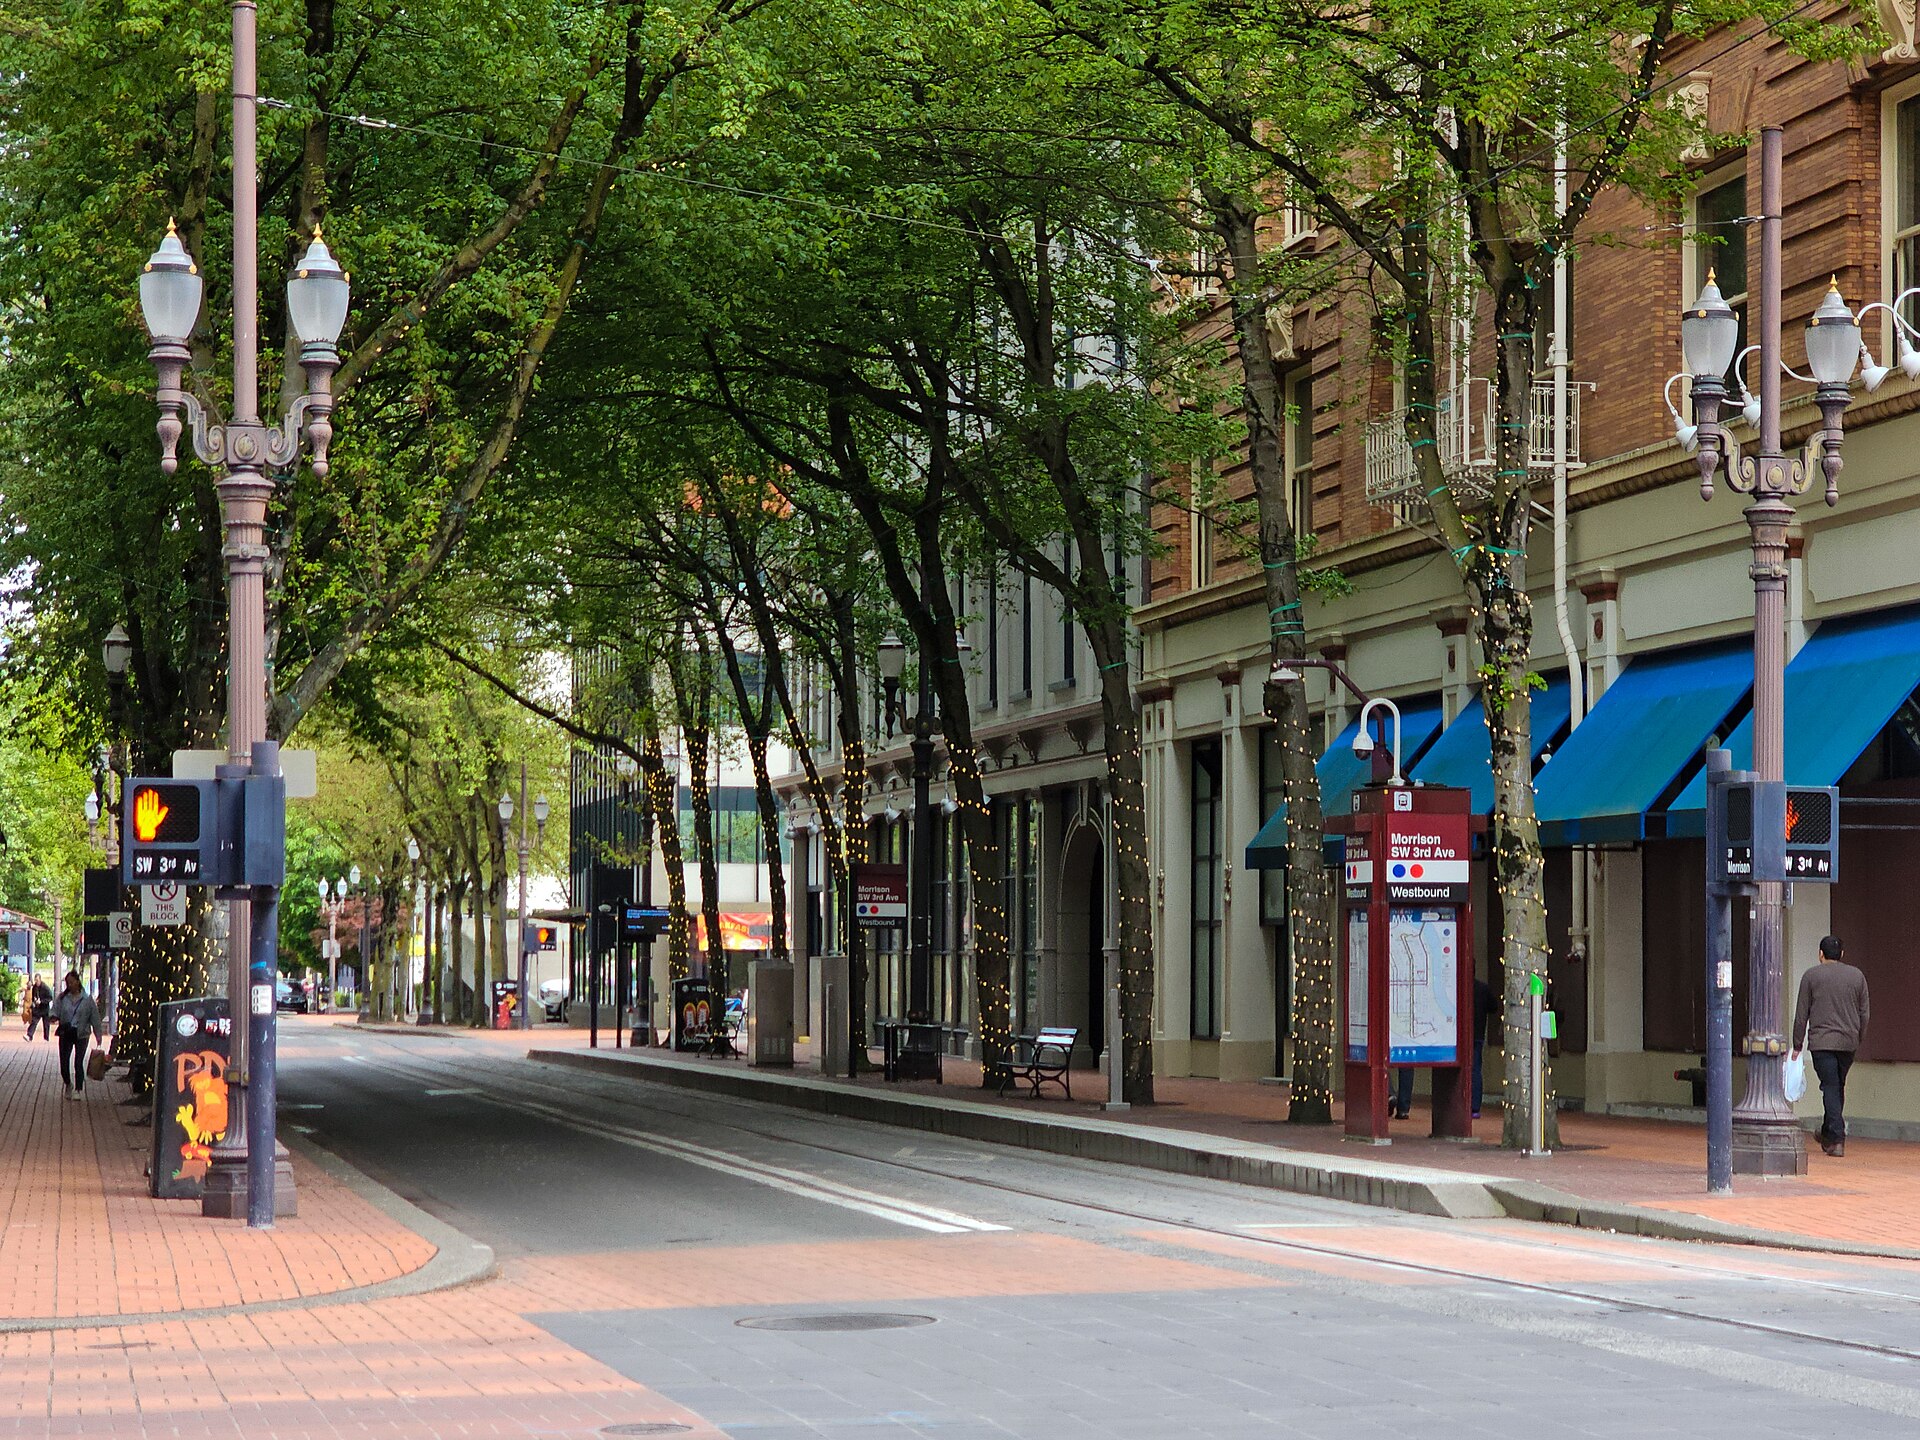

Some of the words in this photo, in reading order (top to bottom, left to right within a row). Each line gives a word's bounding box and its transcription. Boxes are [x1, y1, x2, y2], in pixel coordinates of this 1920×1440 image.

[1391, 832, 1441, 845] Morrison
[1391, 846, 1410, 858] SW
[1412, 846, 1431, 858] 3rd
[1434, 846, 1455, 858] Ave
[136, 856, 153, 873] SW
[160, 856, 177, 873] 3rd
[184, 859, 197, 873] Av
[1727, 860, 1751, 874] Morrison
[1785, 856, 1793, 871] W
[1797, 856, 1812, 872] 3rd
[1818, 858, 1829, 872] Av
[857, 885, 890, 893] Morrison
[1391, 886, 1450, 898] Westbound
[858, 893, 870, 901] SW
[872, 893, 884, 901] 3rd
[885, 893, 899, 901] Ave
[156, 903, 174, 911] THIS
[150, 912, 179, 920] BLOCK
[1392, 914, 1414, 924] MAX
[173, 1050, 231, 1093] PD
